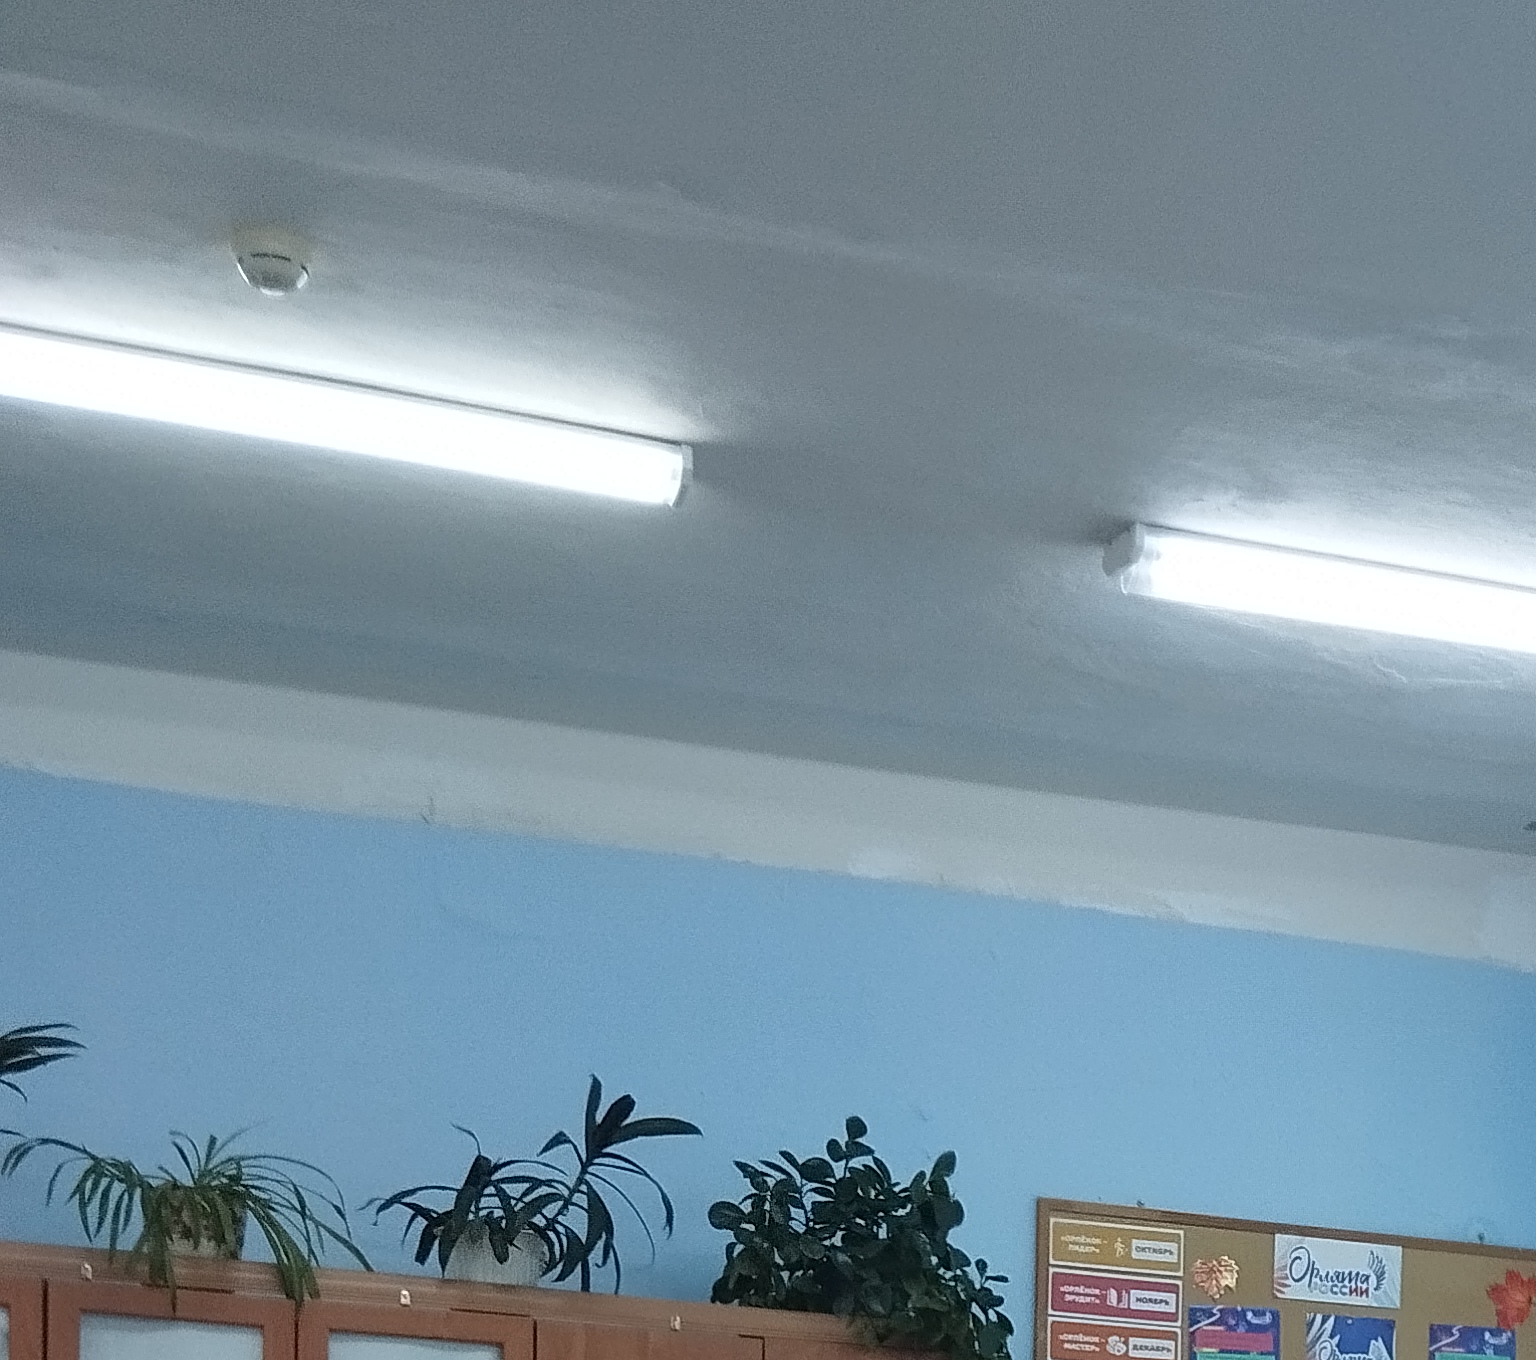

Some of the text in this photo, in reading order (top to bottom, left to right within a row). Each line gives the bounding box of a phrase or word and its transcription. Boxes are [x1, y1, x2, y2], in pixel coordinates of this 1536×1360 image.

[1134, 1245, 1174, 1256] ОКТЯБРЬ
[1289, 1246, 1371, 1289] Орлята
[1308, 1281, 1370, 1298] РОССИИ
[1135, 1296, 1170, 1306] НОЯБРЬ
[1132, 1343, 1172, 1353] ДЕКАБРЬ
